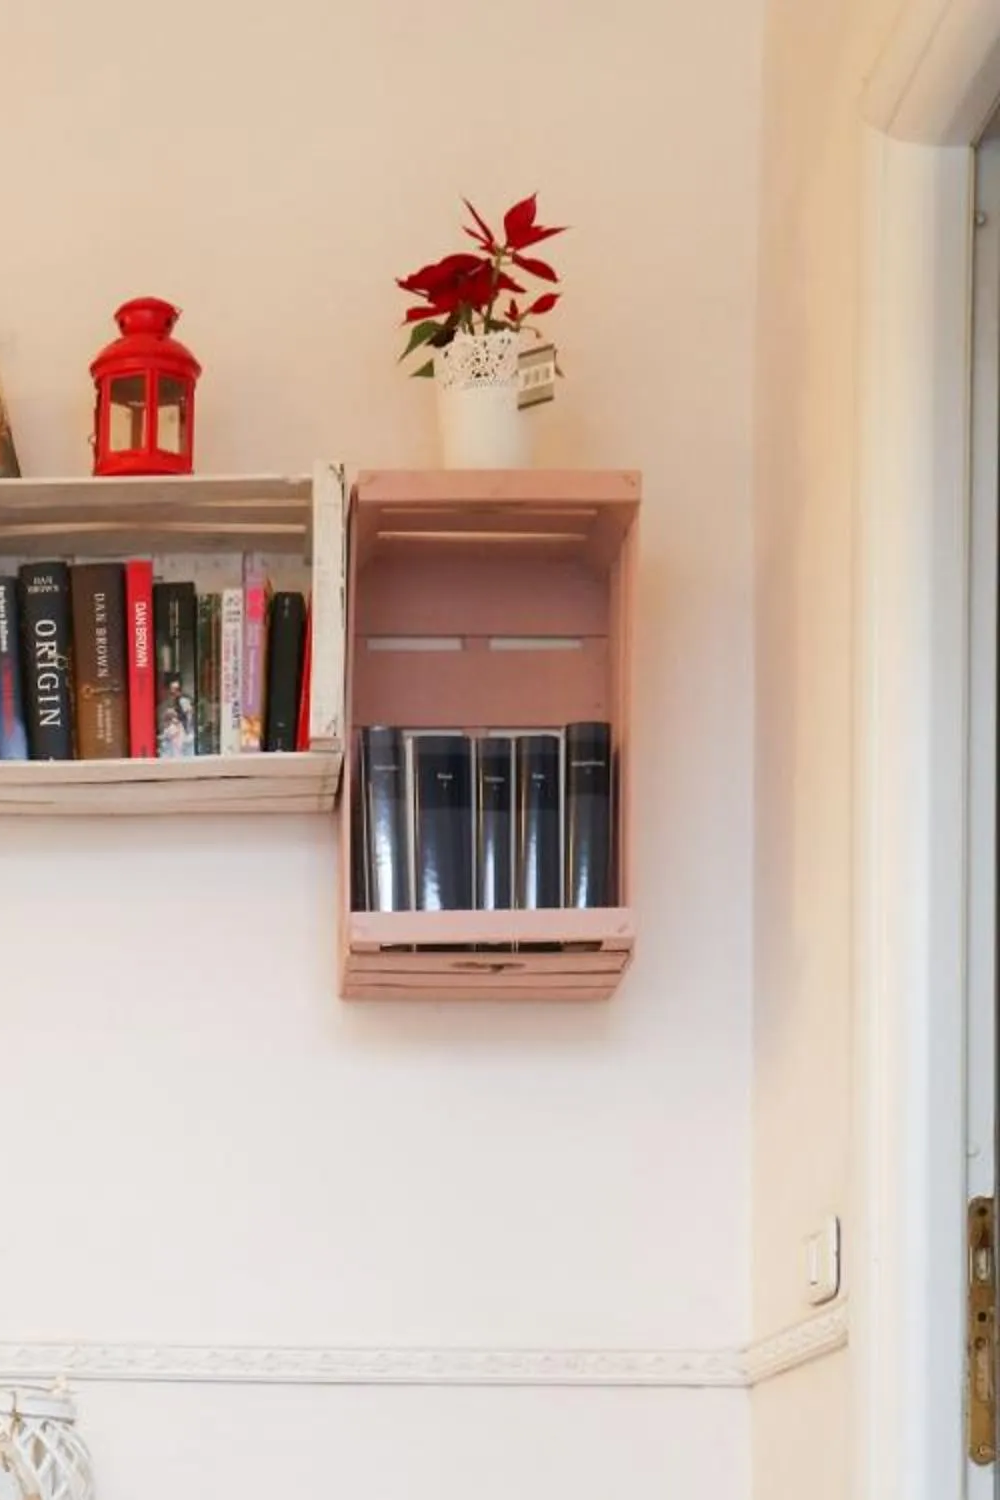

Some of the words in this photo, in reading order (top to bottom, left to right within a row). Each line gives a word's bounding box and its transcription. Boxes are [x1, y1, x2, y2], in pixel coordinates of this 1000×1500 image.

[94, 593, 105, 622] DAN
[135, 601, 148, 626] DAN
[95, 627, 110, 677] BROWN
[135, 627, 149, 668] BROWN
[35, 619, 61, 727] ORIGIN
